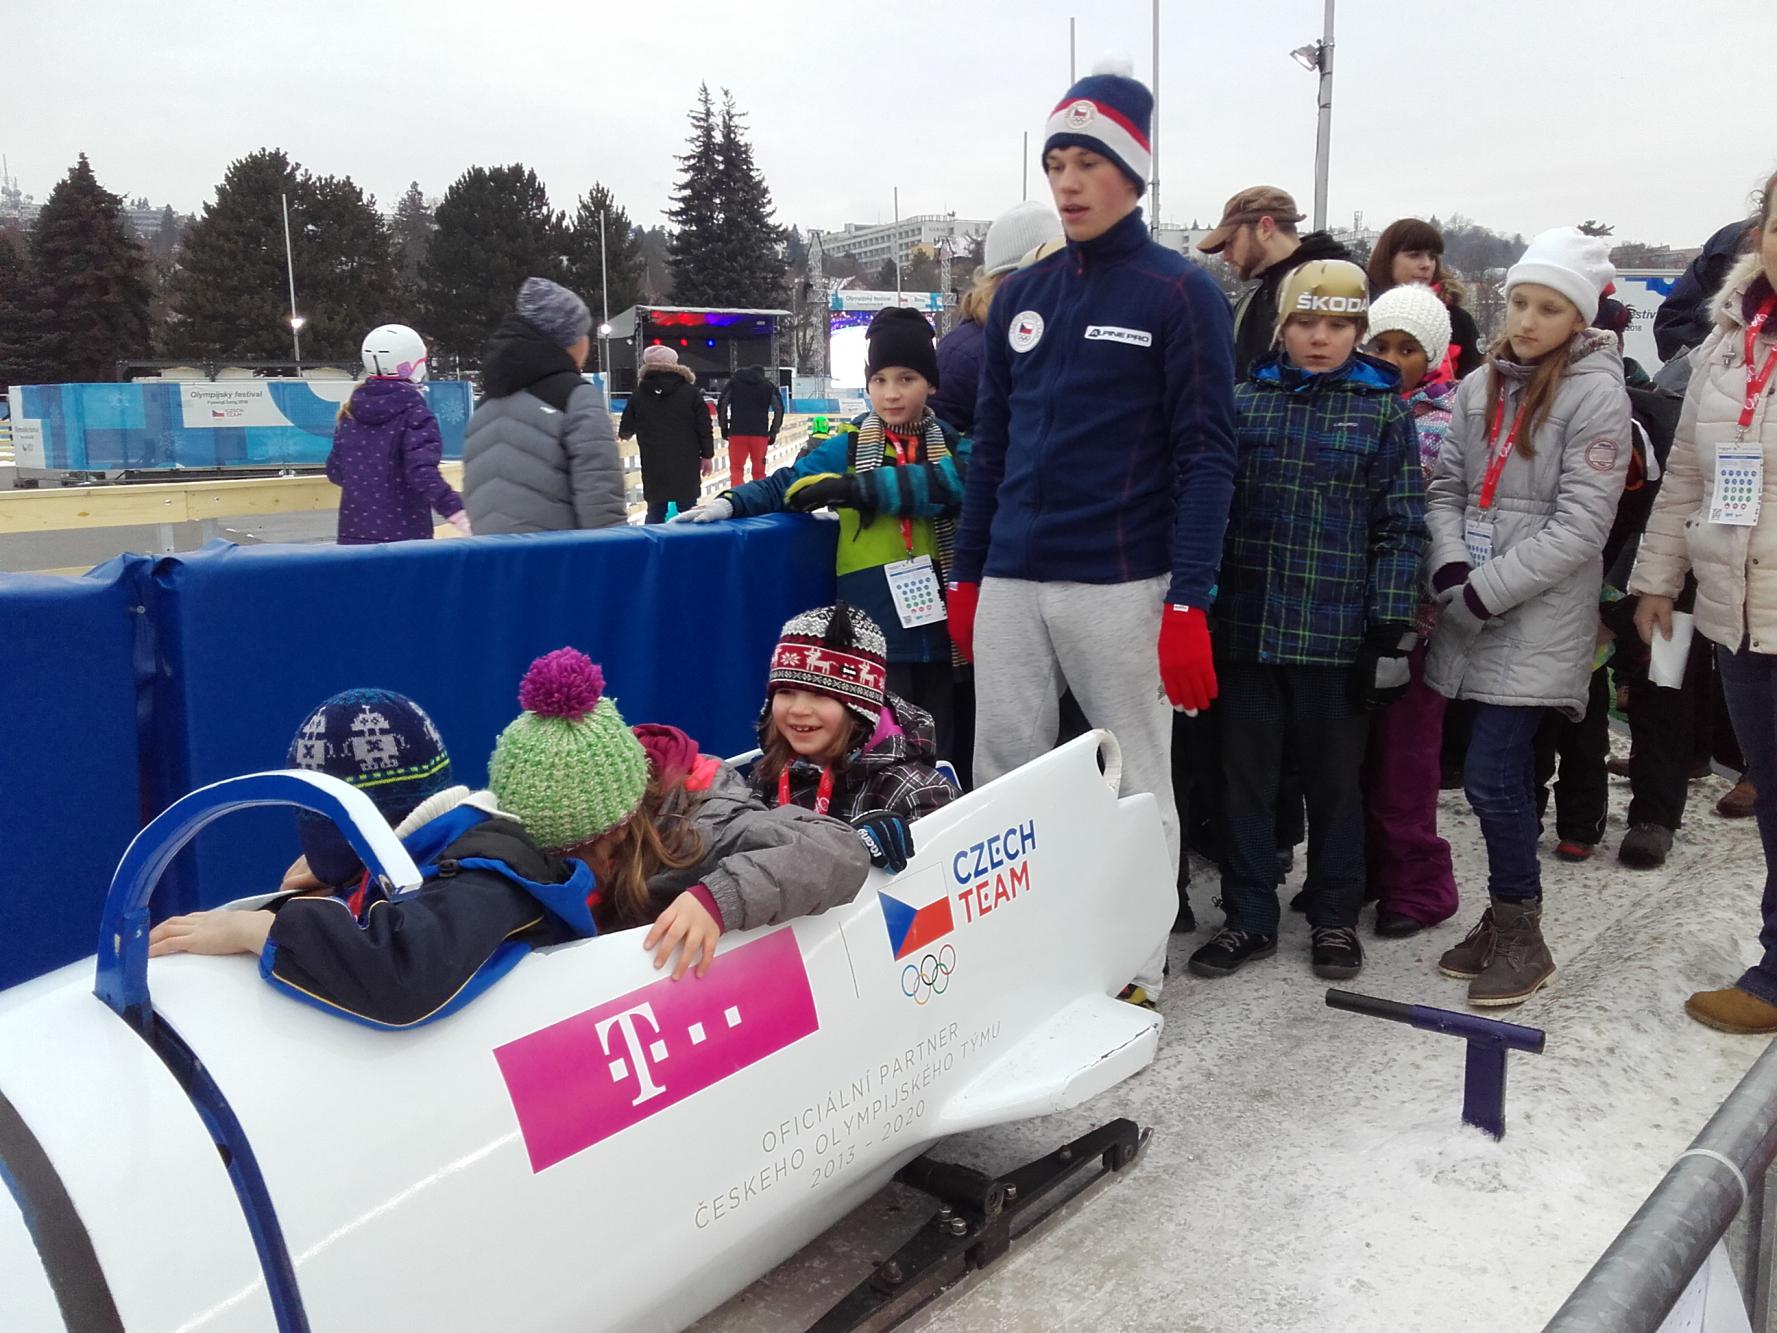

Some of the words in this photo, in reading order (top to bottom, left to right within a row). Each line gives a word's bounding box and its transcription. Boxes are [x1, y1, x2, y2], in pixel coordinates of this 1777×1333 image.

[1296, 291, 1370, 312] ŠKODA
[1630, 310, 1657, 320] estiv
[1088, 328, 1125, 338] ALPINE
[1127, 333, 1150, 342] PRO
[953, 819, 1037, 885] CZECH
[958, 860, 1031, 923] TEAM
[762, 1069, 870, 1153] OFICIÁLNÍ
[880, 1021, 958, 1085] PARTNER
[815, 1052, 954, 1155] OLYMPIJSKÉHO
[961, 1020, 1001, 1060] TÝMU
[810, 1144, 856, 1189] 2013
[881, 1099, 926, 1141] 2020
